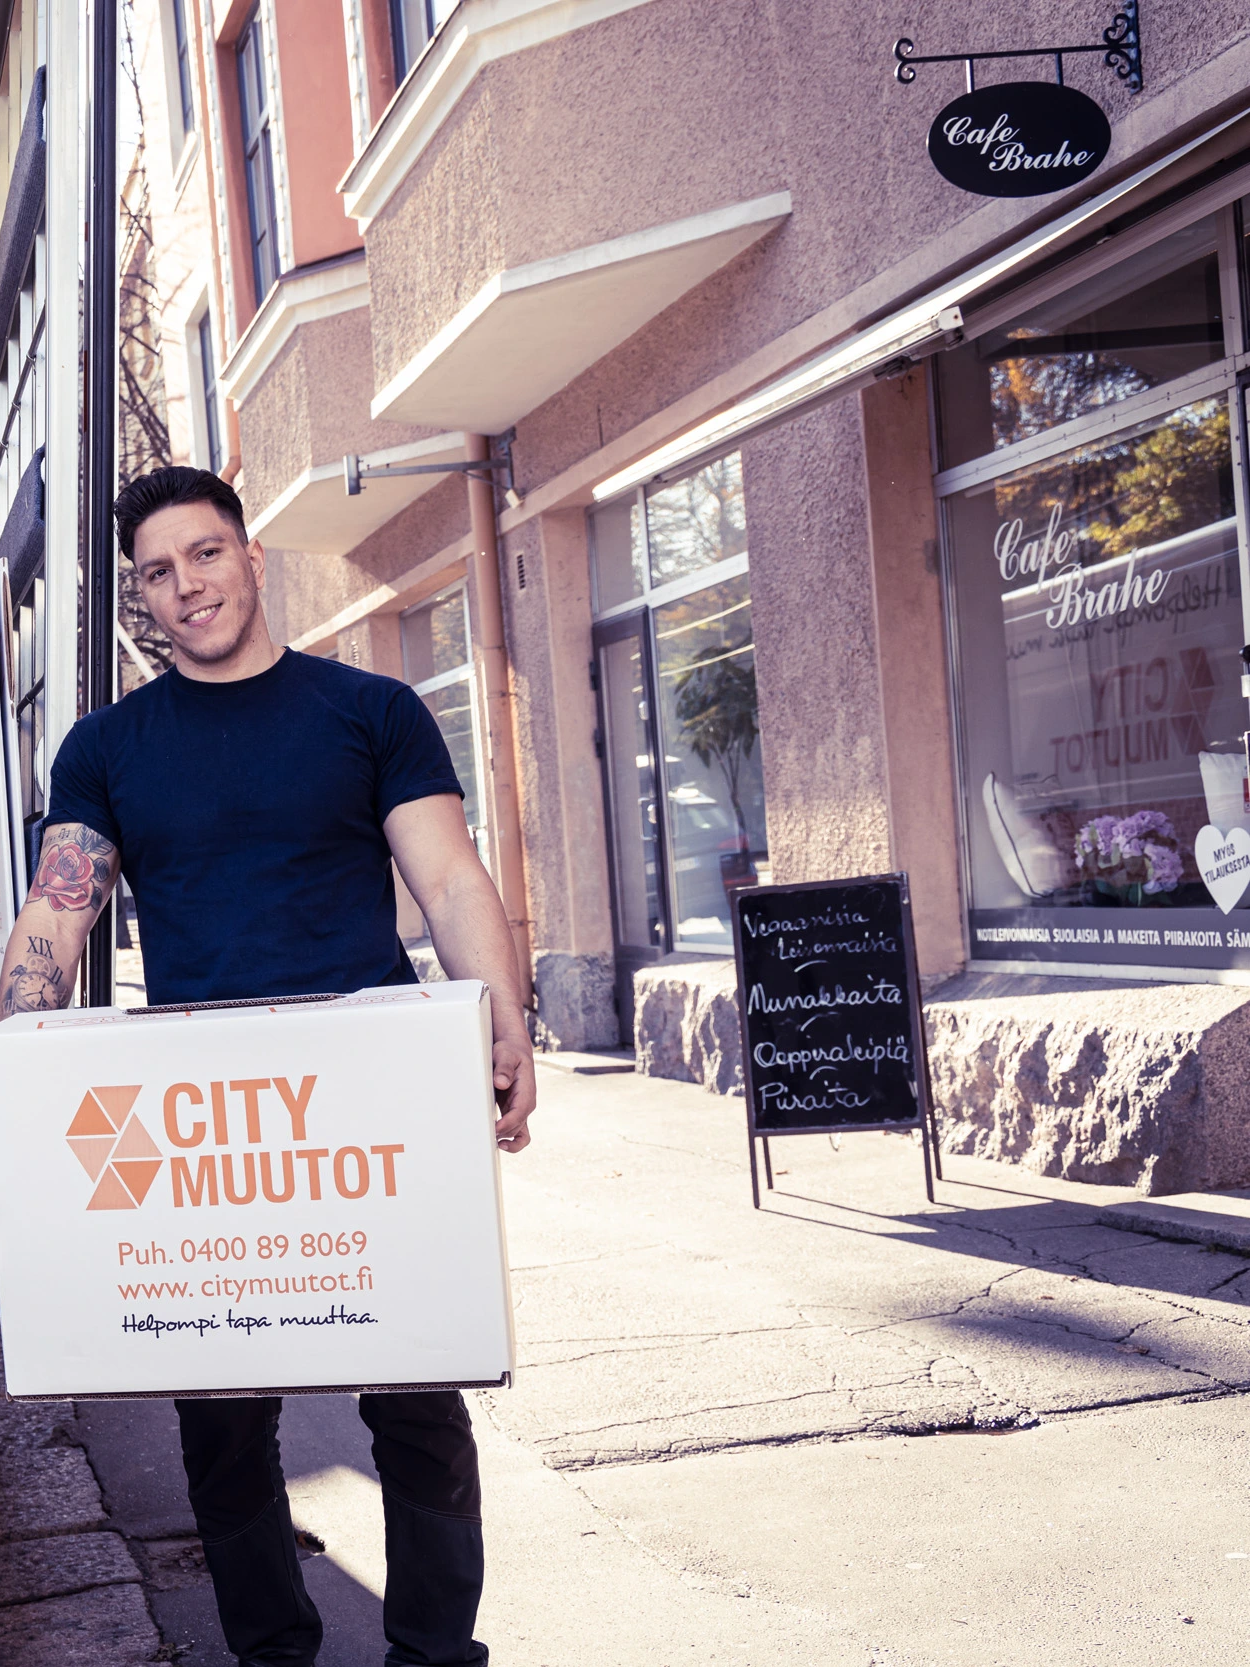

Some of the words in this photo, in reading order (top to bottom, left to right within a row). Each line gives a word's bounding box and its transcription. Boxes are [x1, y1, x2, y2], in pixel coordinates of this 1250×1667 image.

[943, 114, 1020, 155] Cafe
[989, 141, 1095, 171] Brahe
[994, 502, 1077, 594] Cafe
[1046, 547, 1172, 629] Brahe
[1052, 928, 1101, 943] SUOLAISIA
[1103, 929, 1115, 944] JA
[1117, 929, 1161, 945] MAKEITA
[1163, 930, 1223, 947] PIIRAKOITA
[162, 1075, 318, 1149] CITY
[170, 1144, 405, 1208] MUUTOT
[118, 1241, 174, 1266] Puh.
[180, 1236, 247, 1263] 0400
[256, 1234, 289, 1260] 89
[299, 1230, 368, 1258] 8069
[117, 1281, 194, 1301] www.
[200, 1265, 374, 1303] citymuutot.fi
[121, 1313, 220, 1339] Helpompi
[225, 1308, 272, 1336] tapa
[279, 1304, 379, 1327] muuttaa.
